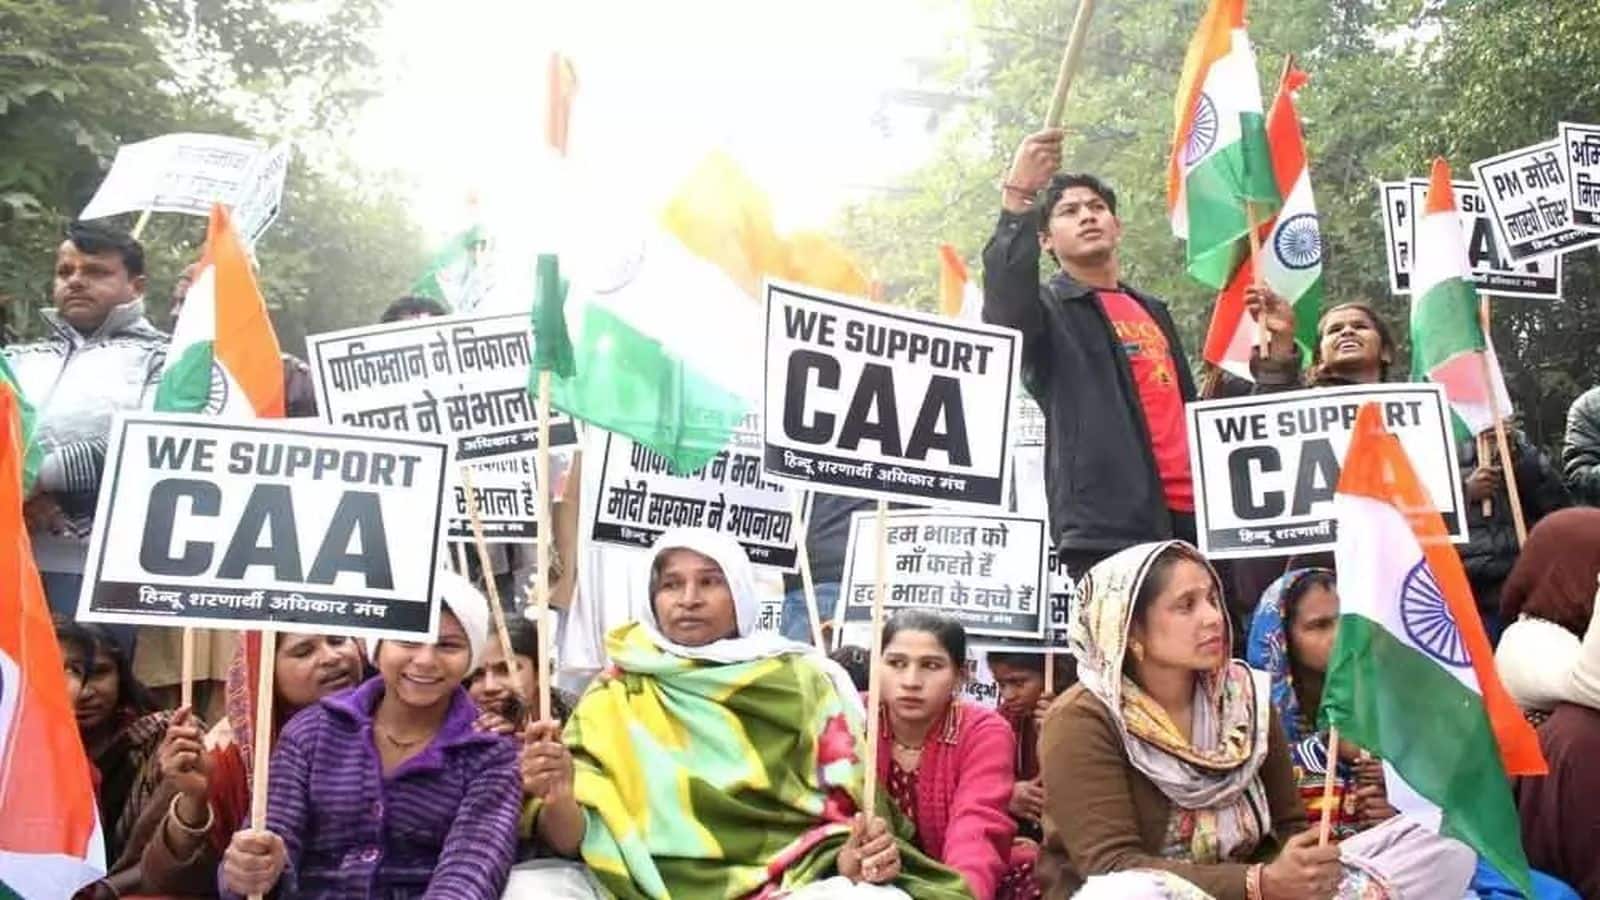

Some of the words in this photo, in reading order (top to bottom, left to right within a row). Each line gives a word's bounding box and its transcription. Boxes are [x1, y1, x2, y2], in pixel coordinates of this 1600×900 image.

[1493, 170, 1524, 200] PM
[1521, 151, 1566, 189] मोदी
[329, 341, 427, 392] पाकिस्तान
[429, 331, 450, 374] ने
[452, 327, 533, 372] निकाला
[785, 305, 836, 347] WE
[845, 320, 994, 375] SUPPORT
[413, 389, 442, 434] ने
[444, 384, 537, 432] संभाला
[783, 348, 973, 467] CAA
[1215, 414, 1269, 443] WE
[1277, 401, 1421, 437] SUPPRT
[147, 436, 216, 472] WE
[228, 443, 421, 487] SUPPORT
[783, 450, 816, 476] हिन्दू
[817, 460, 874, 480] शरणार्थी
[877, 467, 935, 489] अधिकार
[1228, 438, 1341, 521] CA
[139, 478, 395, 590] CAA
[607, 480, 647, 522] मोदी
[648, 492, 705, 528] सरकार
[706, 493, 726, 532] ने
[726, 504, 792, 543] अपनाया
[887, 525, 918, 544] हम
[923, 525, 976, 546] भारत
[981, 522, 1009, 548] को
[896, 546, 926, 574] माँ
[926, 550, 973, 577] कहते
[139, 586, 185, 609] हिन्दू
[188, 590, 264, 610] शरणार्थी
[268, 595, 346, 617] अधिकार
[353, 600, 388, 618] मंच
[891, 583, 943, 605] भारत
[1017, 584, 1036, 612] हैं
